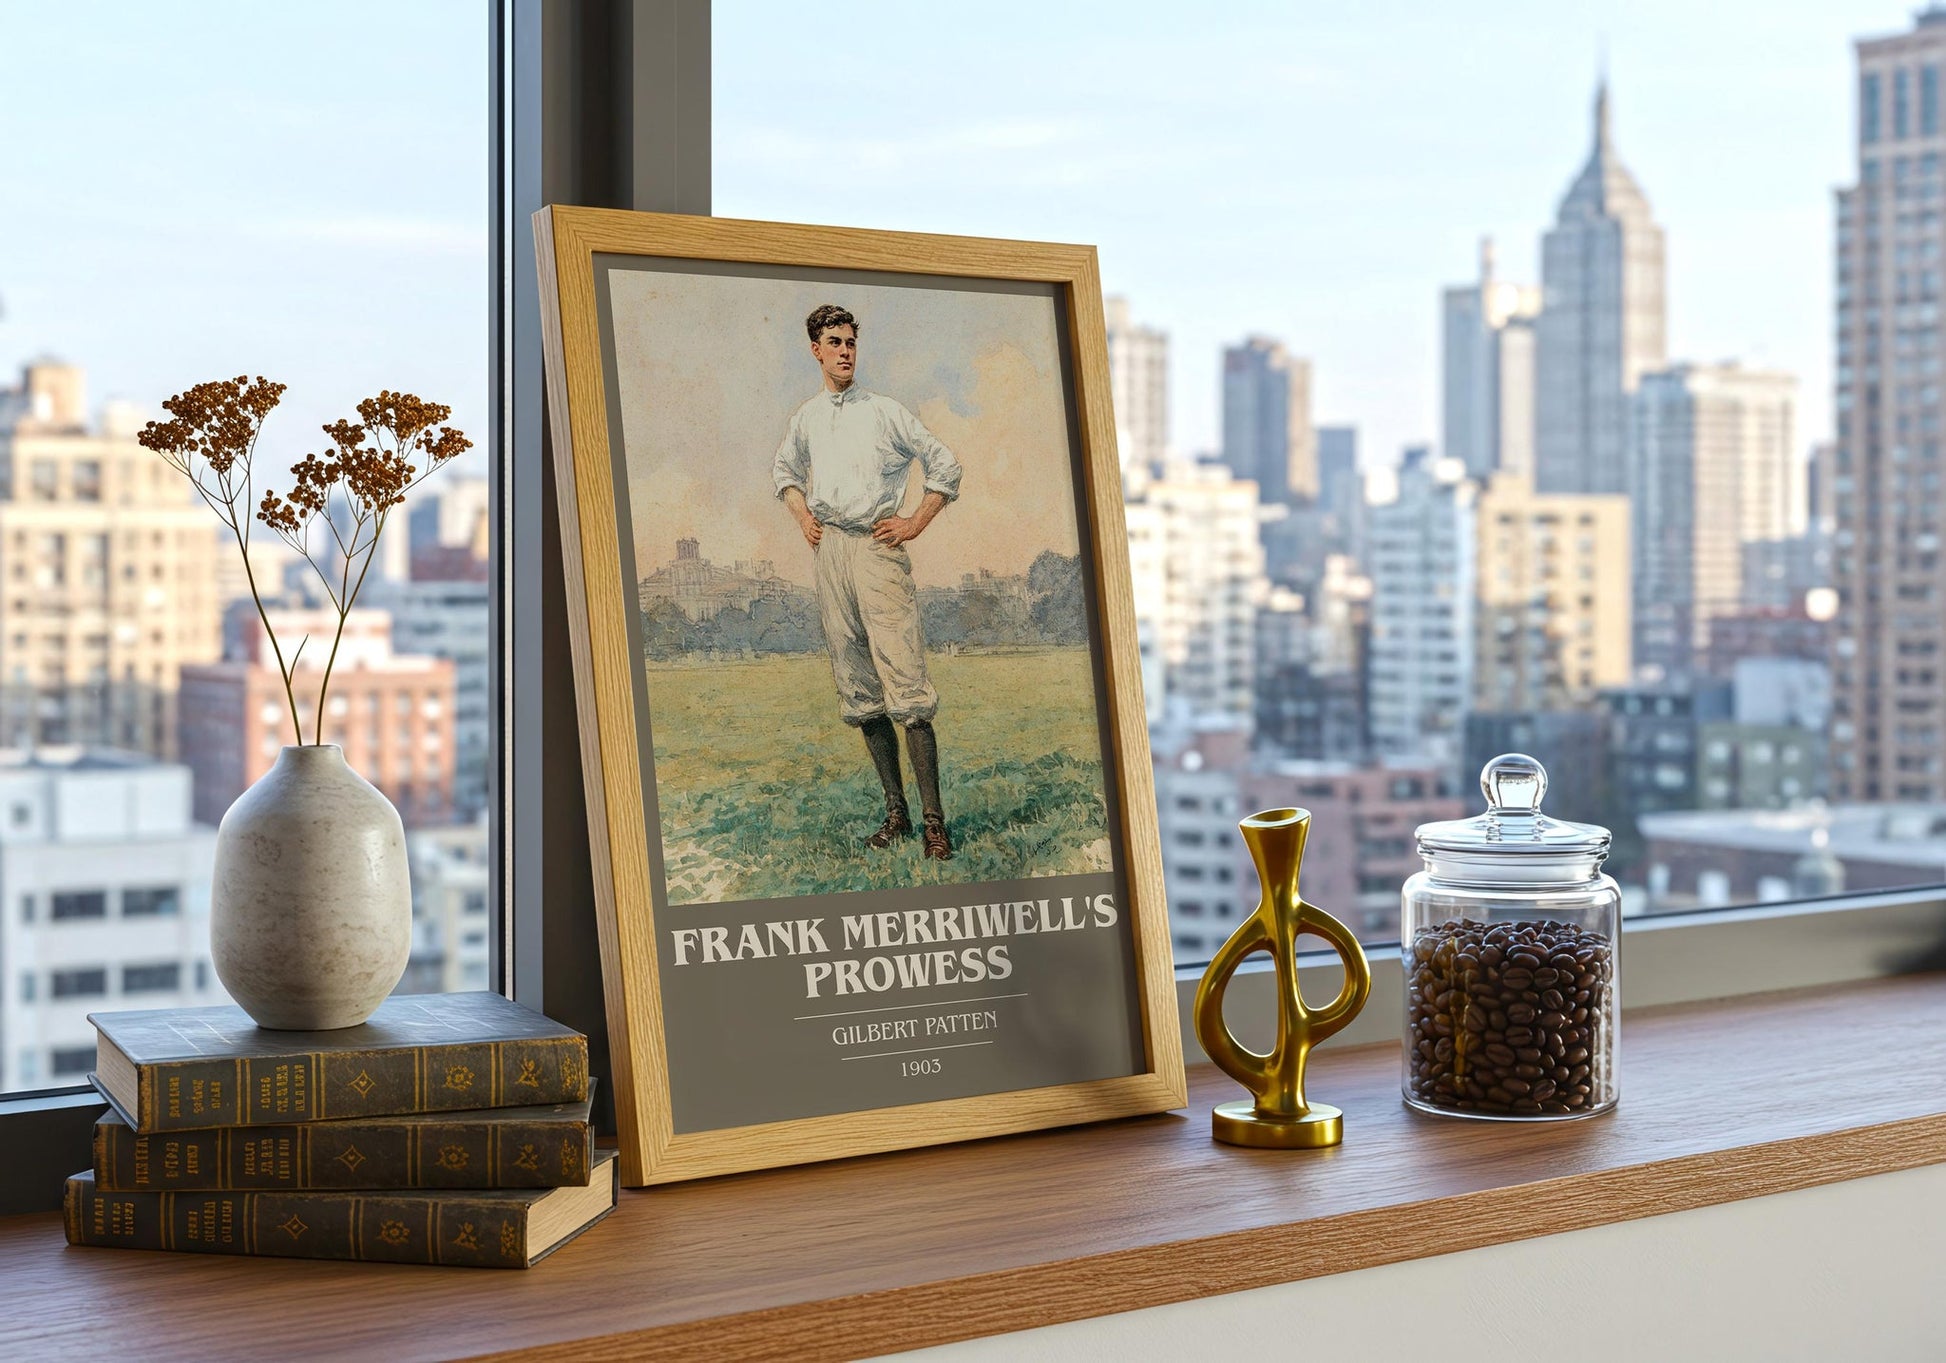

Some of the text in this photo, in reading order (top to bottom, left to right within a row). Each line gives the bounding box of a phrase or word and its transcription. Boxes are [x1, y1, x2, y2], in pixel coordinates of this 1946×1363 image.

[671, 893, 1119, 967] FRANK MERRIWELL'S
[802, 944, 1014, 999] PROWESS
[831, 1010, 998, 1047] GILBERT PATTEN
[900, 1058, 942, 1078] 1903
